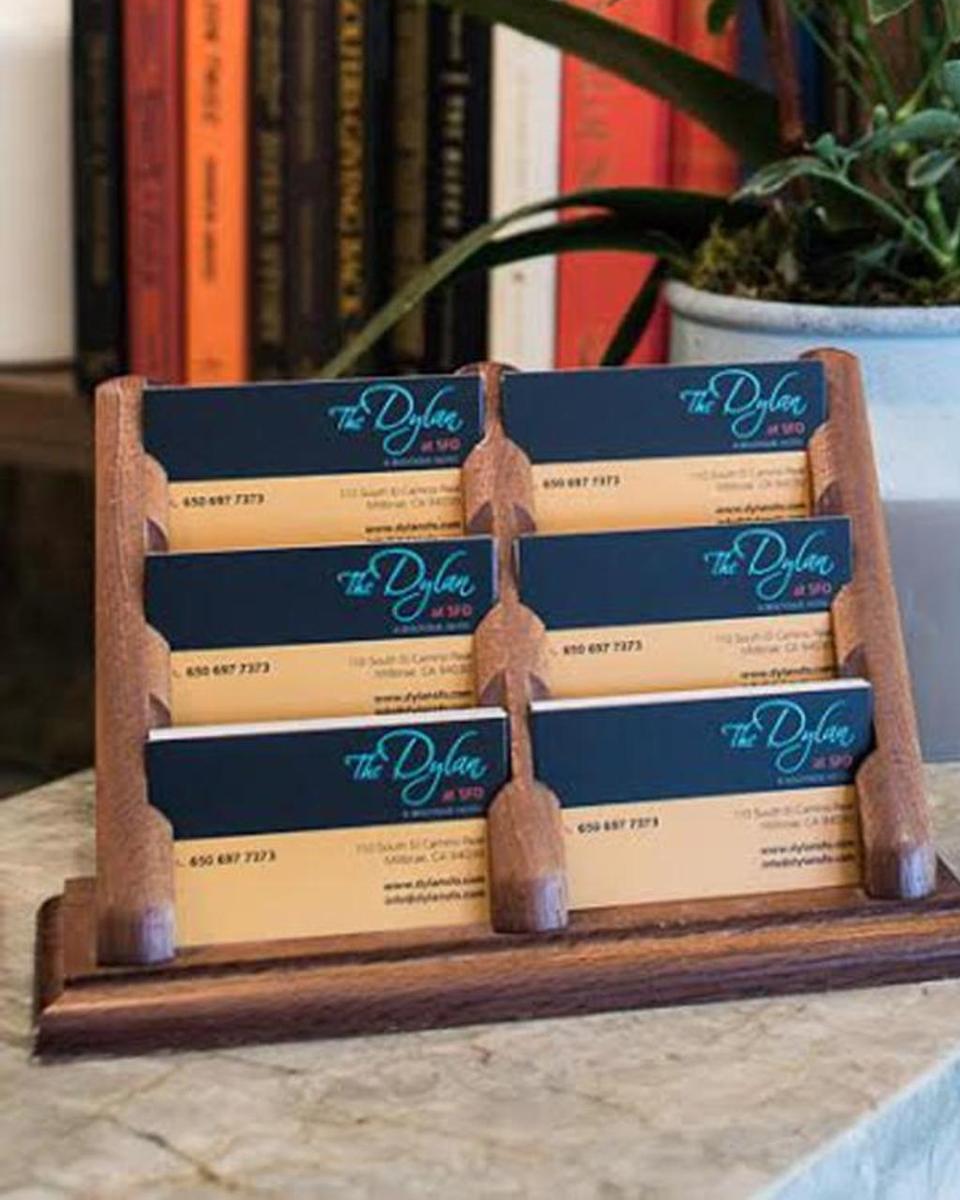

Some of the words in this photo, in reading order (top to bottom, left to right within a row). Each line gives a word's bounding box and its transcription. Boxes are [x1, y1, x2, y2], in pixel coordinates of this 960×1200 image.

[361, 384, 463, 455] Dylan
[709, 368, 808, 439] Dylan
[370, 549, 476, 622] Dylan
[734, 527, 834, 601] Dylan
[377, 728, 487, 806] Dylan
[752, 698, 856, 773] Dylan
